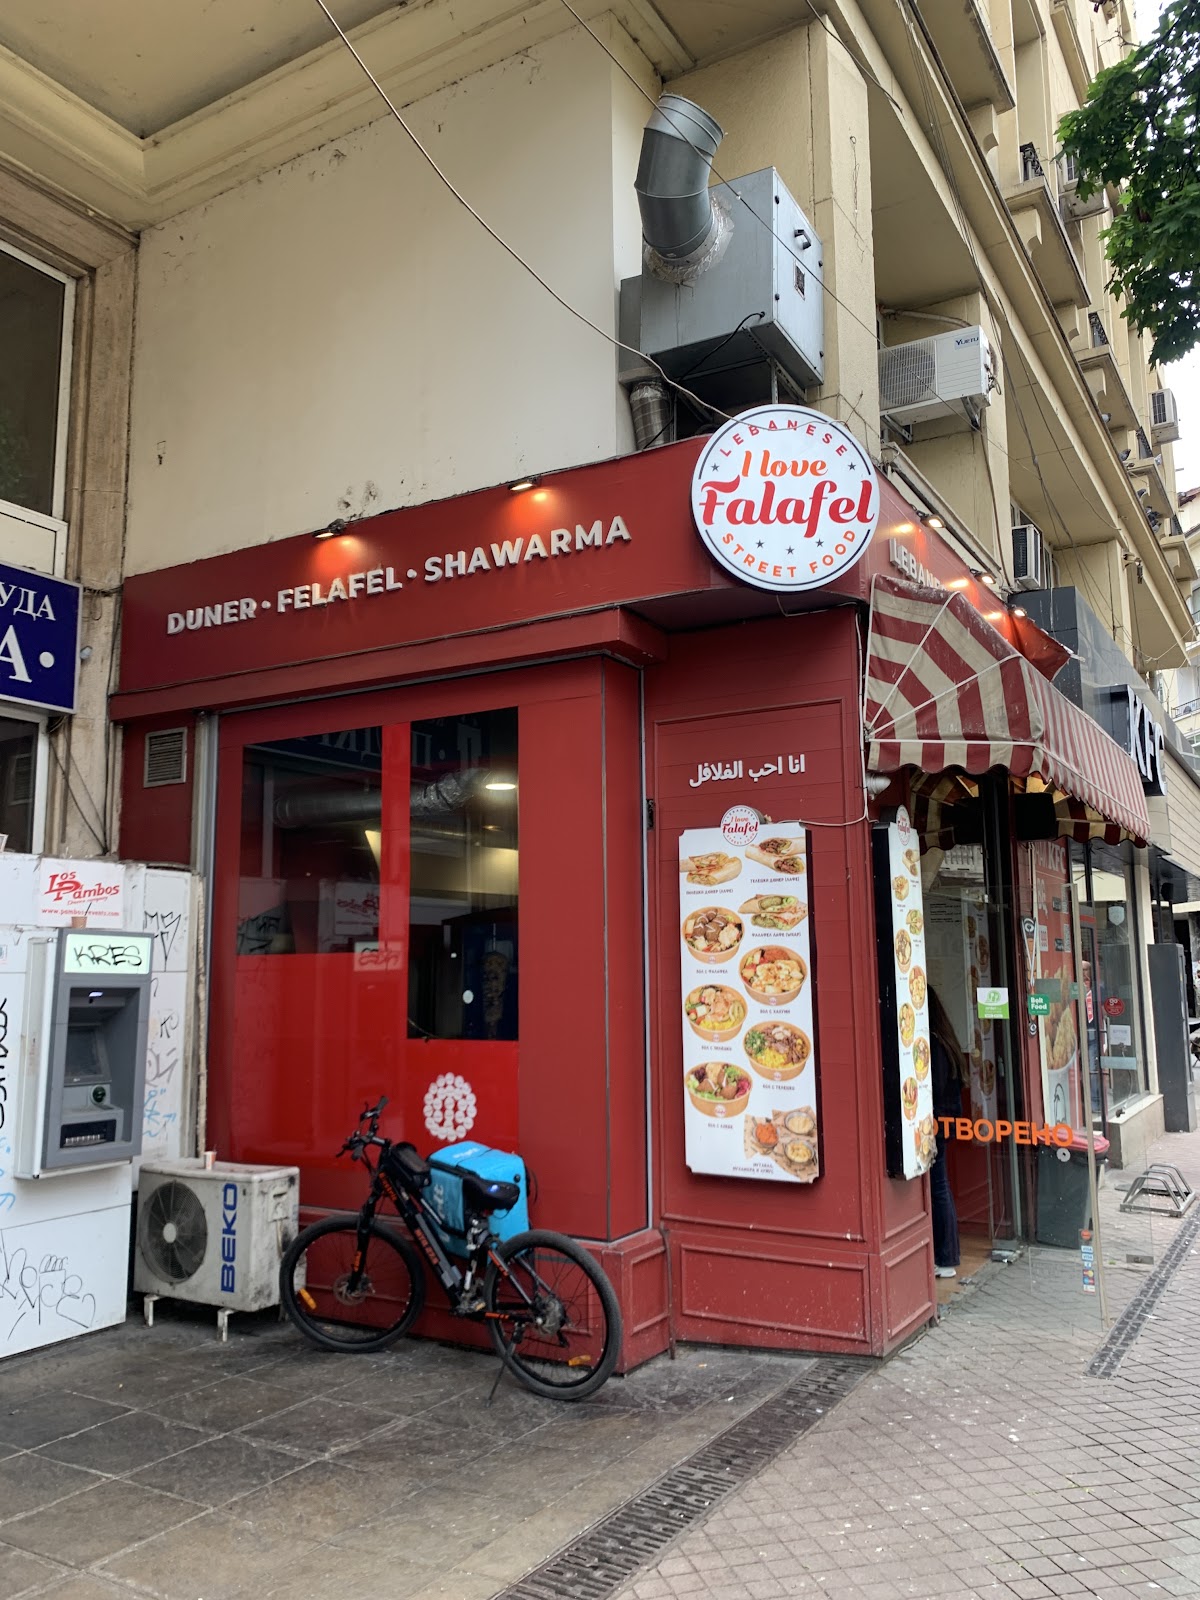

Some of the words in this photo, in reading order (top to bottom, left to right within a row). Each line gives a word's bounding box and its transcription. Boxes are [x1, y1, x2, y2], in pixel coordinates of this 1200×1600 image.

[719, 419, 848, 457] LEBANESE
[741, 450, 753, 477] I
[760, 449, 829, 477] love
[699, 475, 875, 538] Falafel
[167, 598, 257, 635] DUNER
[277, 566, 403, 612] FELAFEL
[424, 516, 631, 582] SHAWARMA
[722, 532, 797, 578] STREET
[808, 530, 856, 574] FOOD
[1127, 684, 1168, 796] KFC
[689, 760, 743, 788] الفلافل
[748, 756, 783, 782] احب
[722, 821, 758, 835] Falafel
[221, 1182, 238, 1293] BEKO
